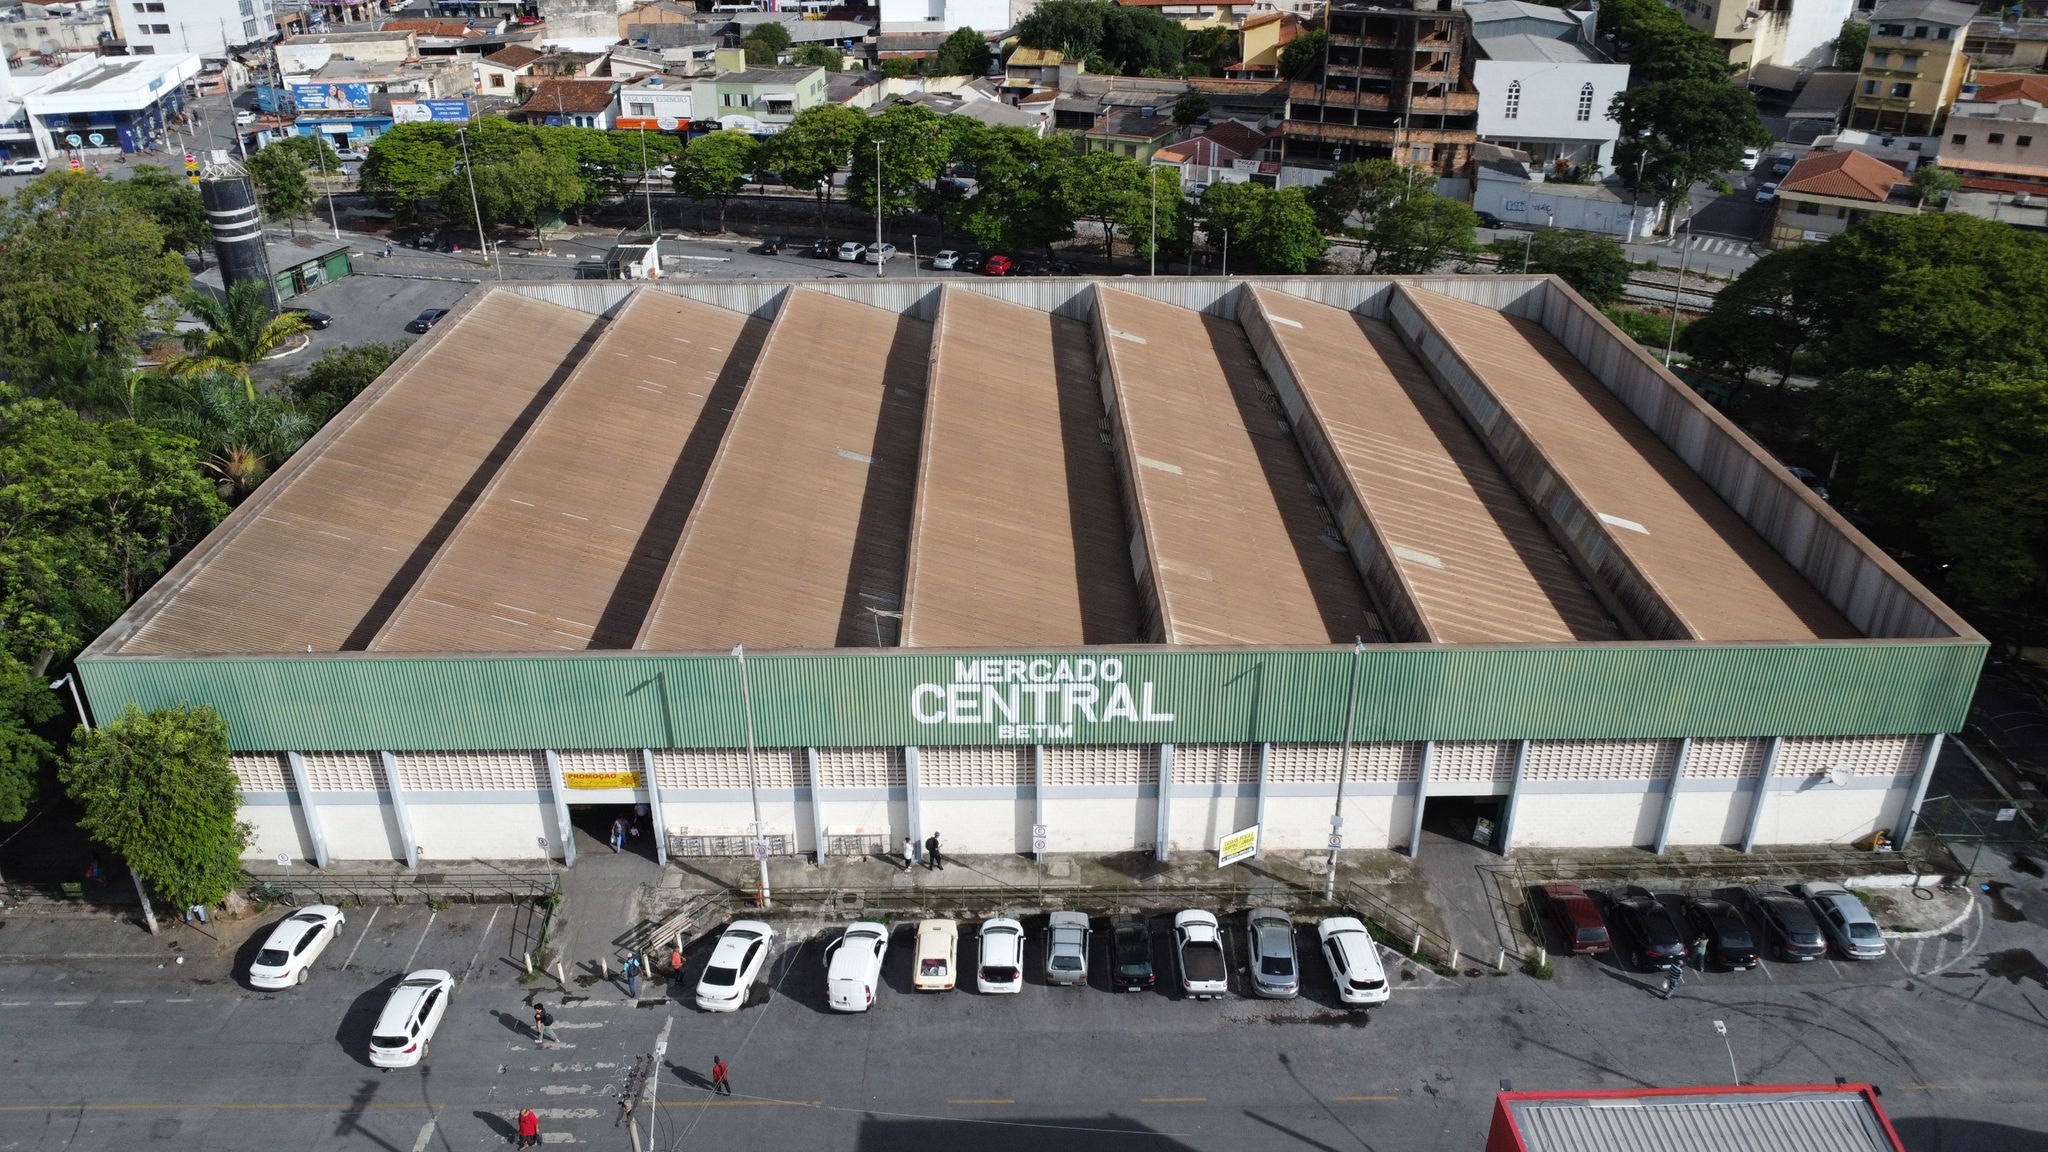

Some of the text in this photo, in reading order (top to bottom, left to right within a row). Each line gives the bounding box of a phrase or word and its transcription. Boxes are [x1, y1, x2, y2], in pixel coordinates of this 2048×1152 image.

[954, 658, 1123, 682] MERCADO
[911, 680, 1175, 724] CENTRAL
[998, 723, 1073, 738] BETIM
